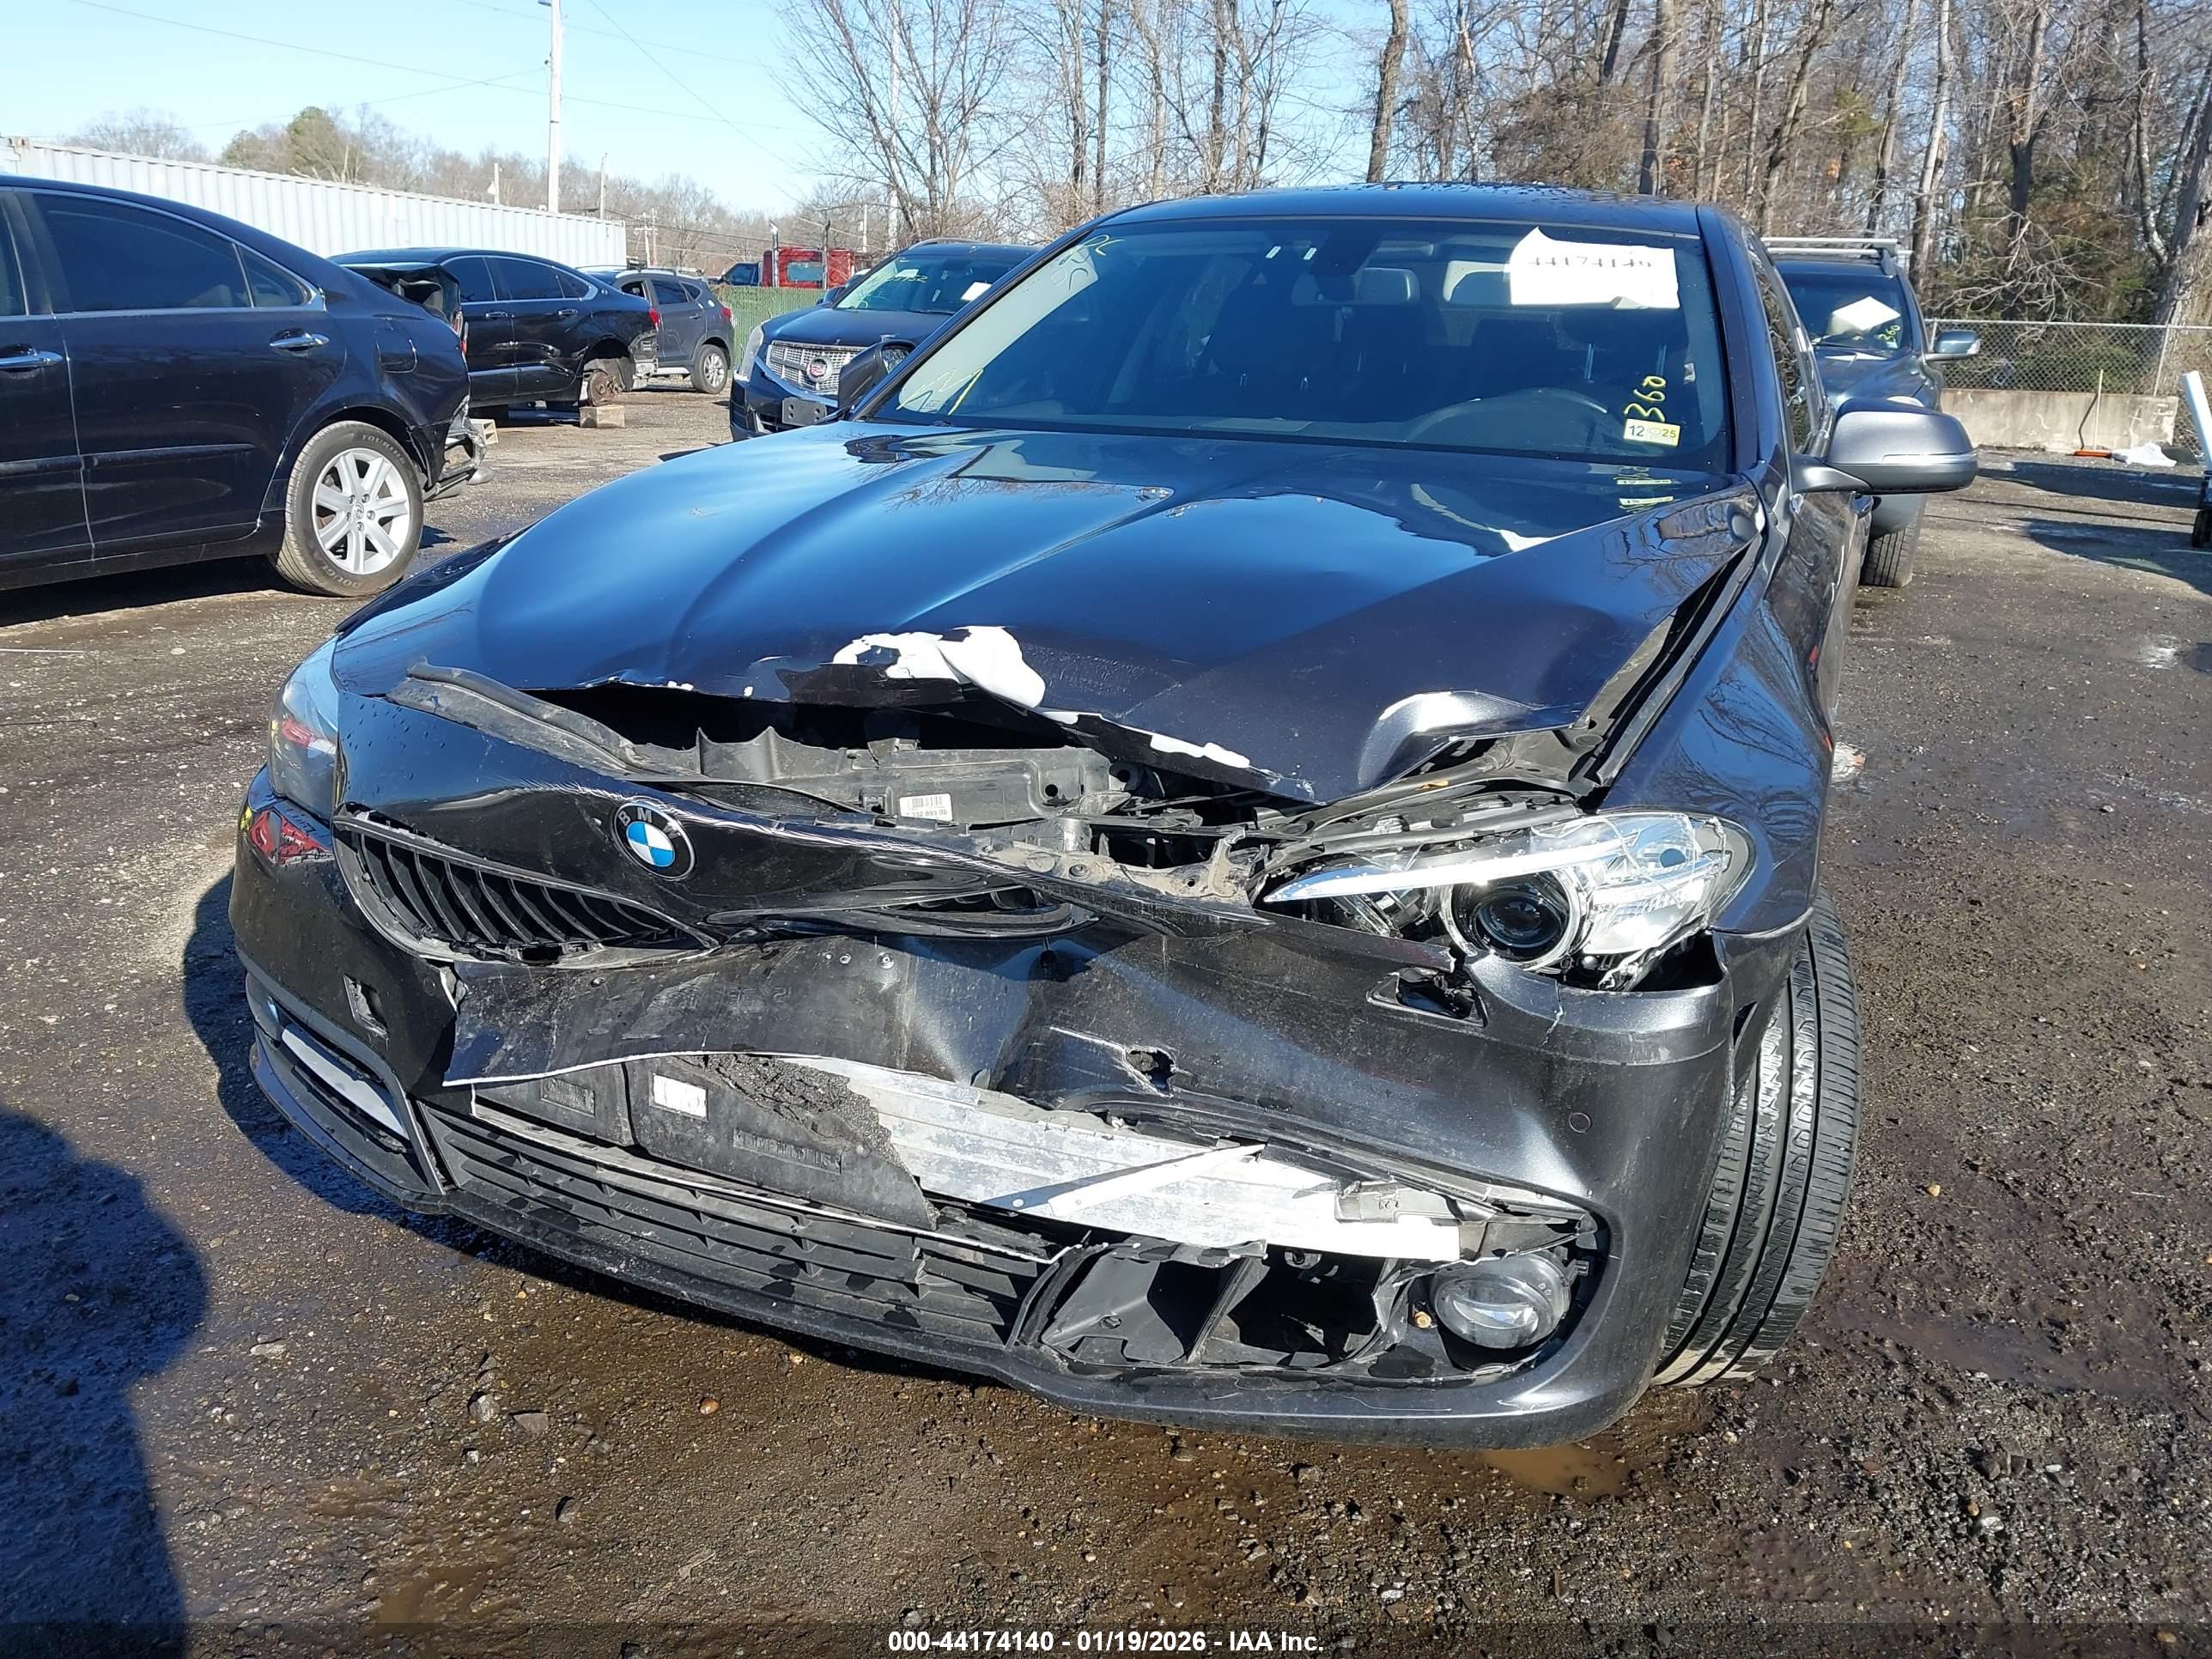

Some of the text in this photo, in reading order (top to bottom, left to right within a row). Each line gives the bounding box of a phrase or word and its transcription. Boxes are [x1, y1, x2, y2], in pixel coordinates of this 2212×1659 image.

[1623, 375, 1667, 422] 360
[1628, 424, 1677, 439] 12 25
[361, 434, 407, 465] TOURING
[618, 807, 682, 840] BMW
